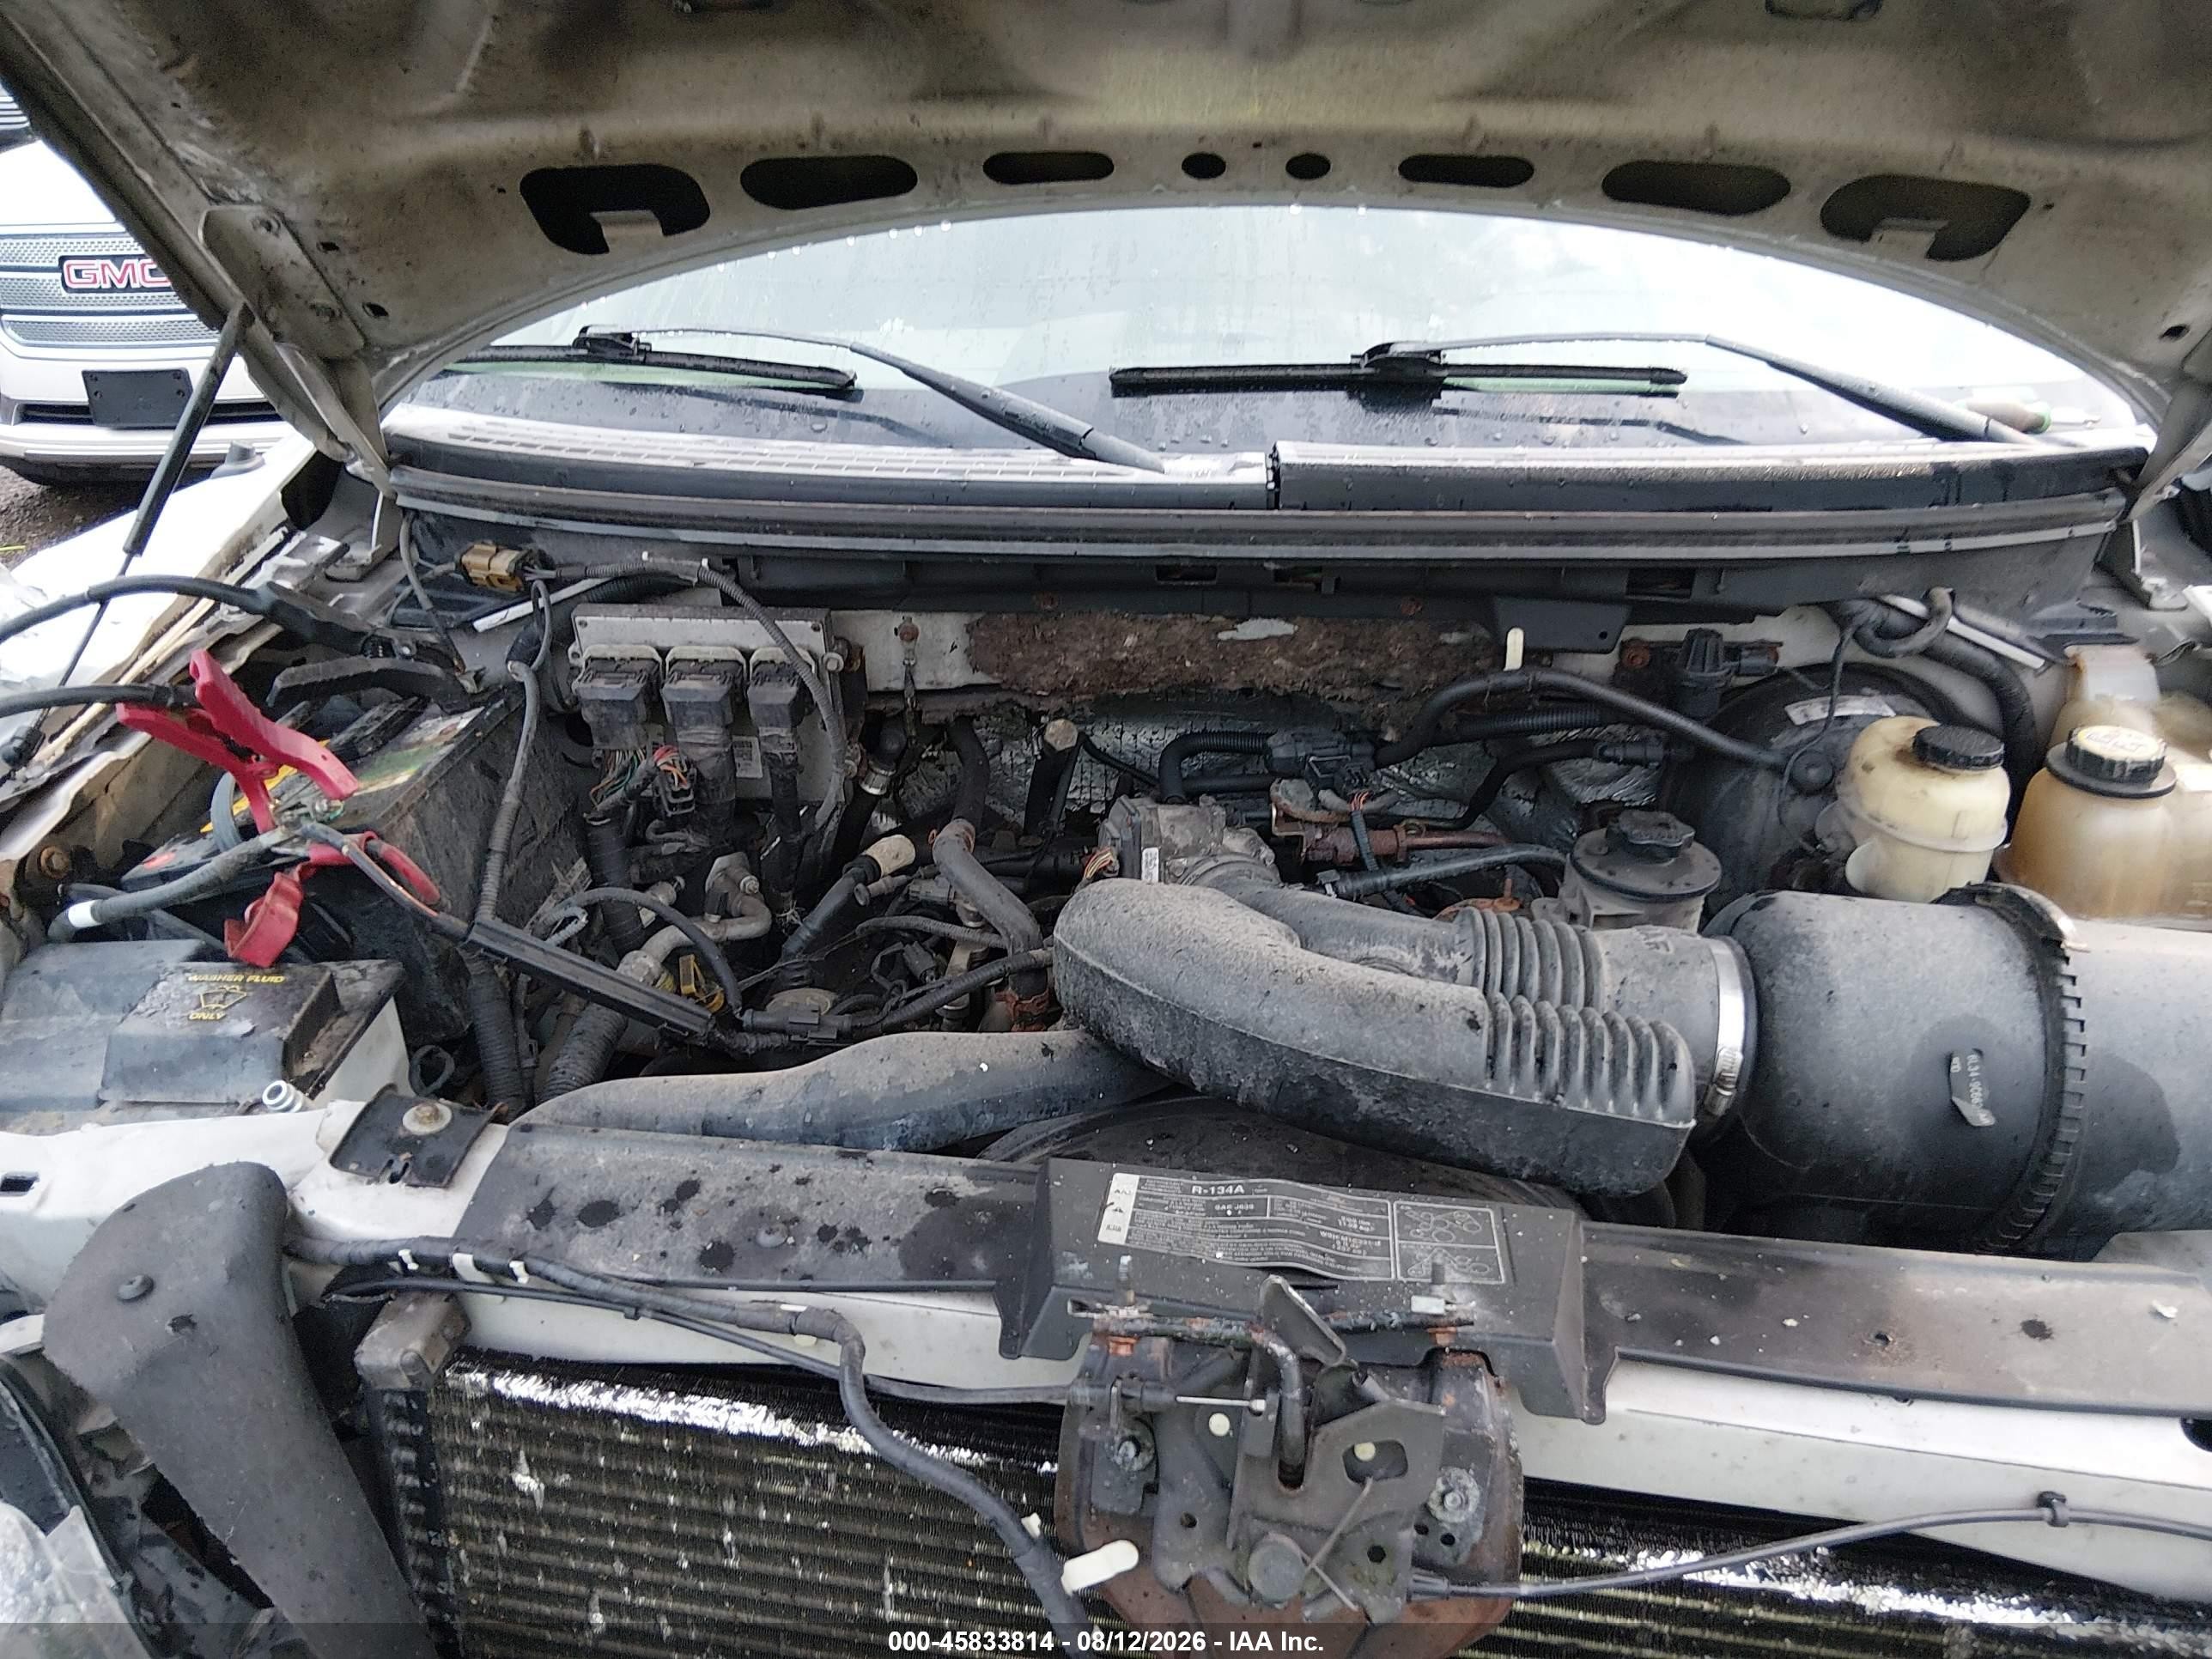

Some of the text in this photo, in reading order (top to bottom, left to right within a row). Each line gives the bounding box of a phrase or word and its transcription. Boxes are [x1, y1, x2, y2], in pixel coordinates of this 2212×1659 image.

[63, 258, 172, 289] GMC
[188, 974, 286, 983] WASHER FLUID
[1191, 1184, 1246, 1195] R-134A
